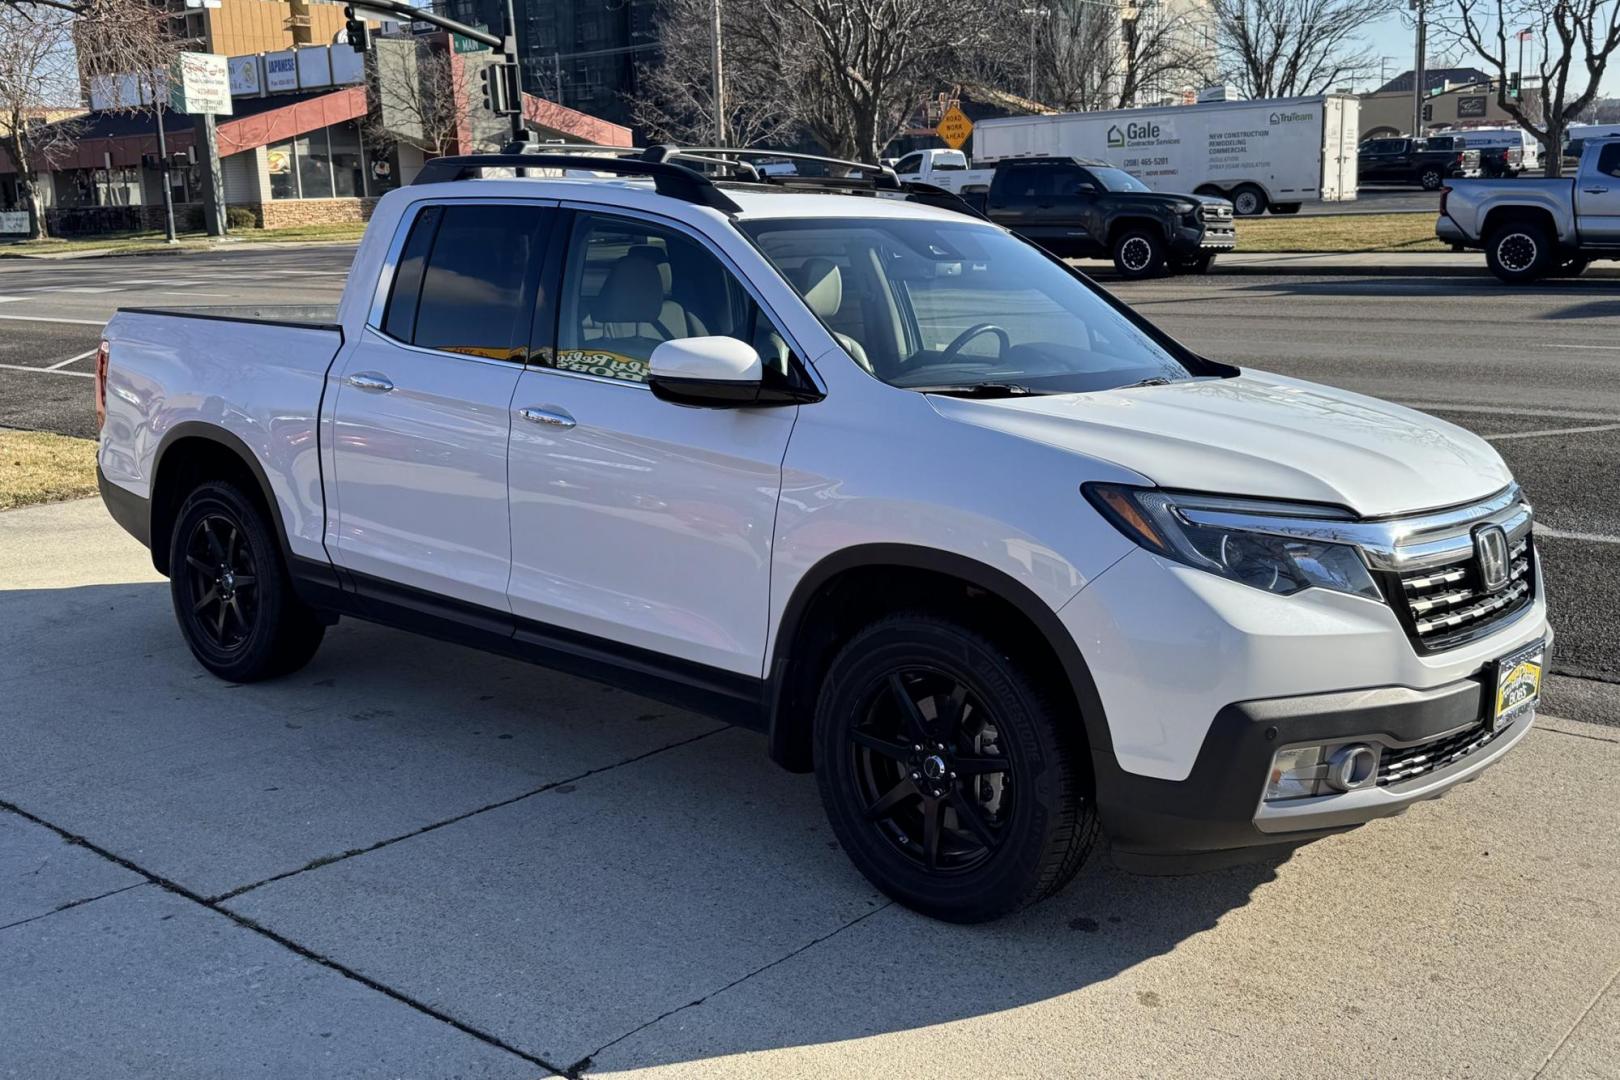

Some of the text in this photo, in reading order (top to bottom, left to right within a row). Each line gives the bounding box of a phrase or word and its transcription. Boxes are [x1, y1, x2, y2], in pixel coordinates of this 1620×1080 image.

[462, 38, 479, 51] MAIN
[268, 59, 296, 74] JAPANESE
[1279, 112, 1313, 122] TruTeam
[1127, 121, 1160, 139] Gale
[1223, 130, 1269, 139] CONSTRUCTION
[1208, 139, 1246, 147] REMODELING
[1208, 146, 1247, 154] COMMERCIAL
